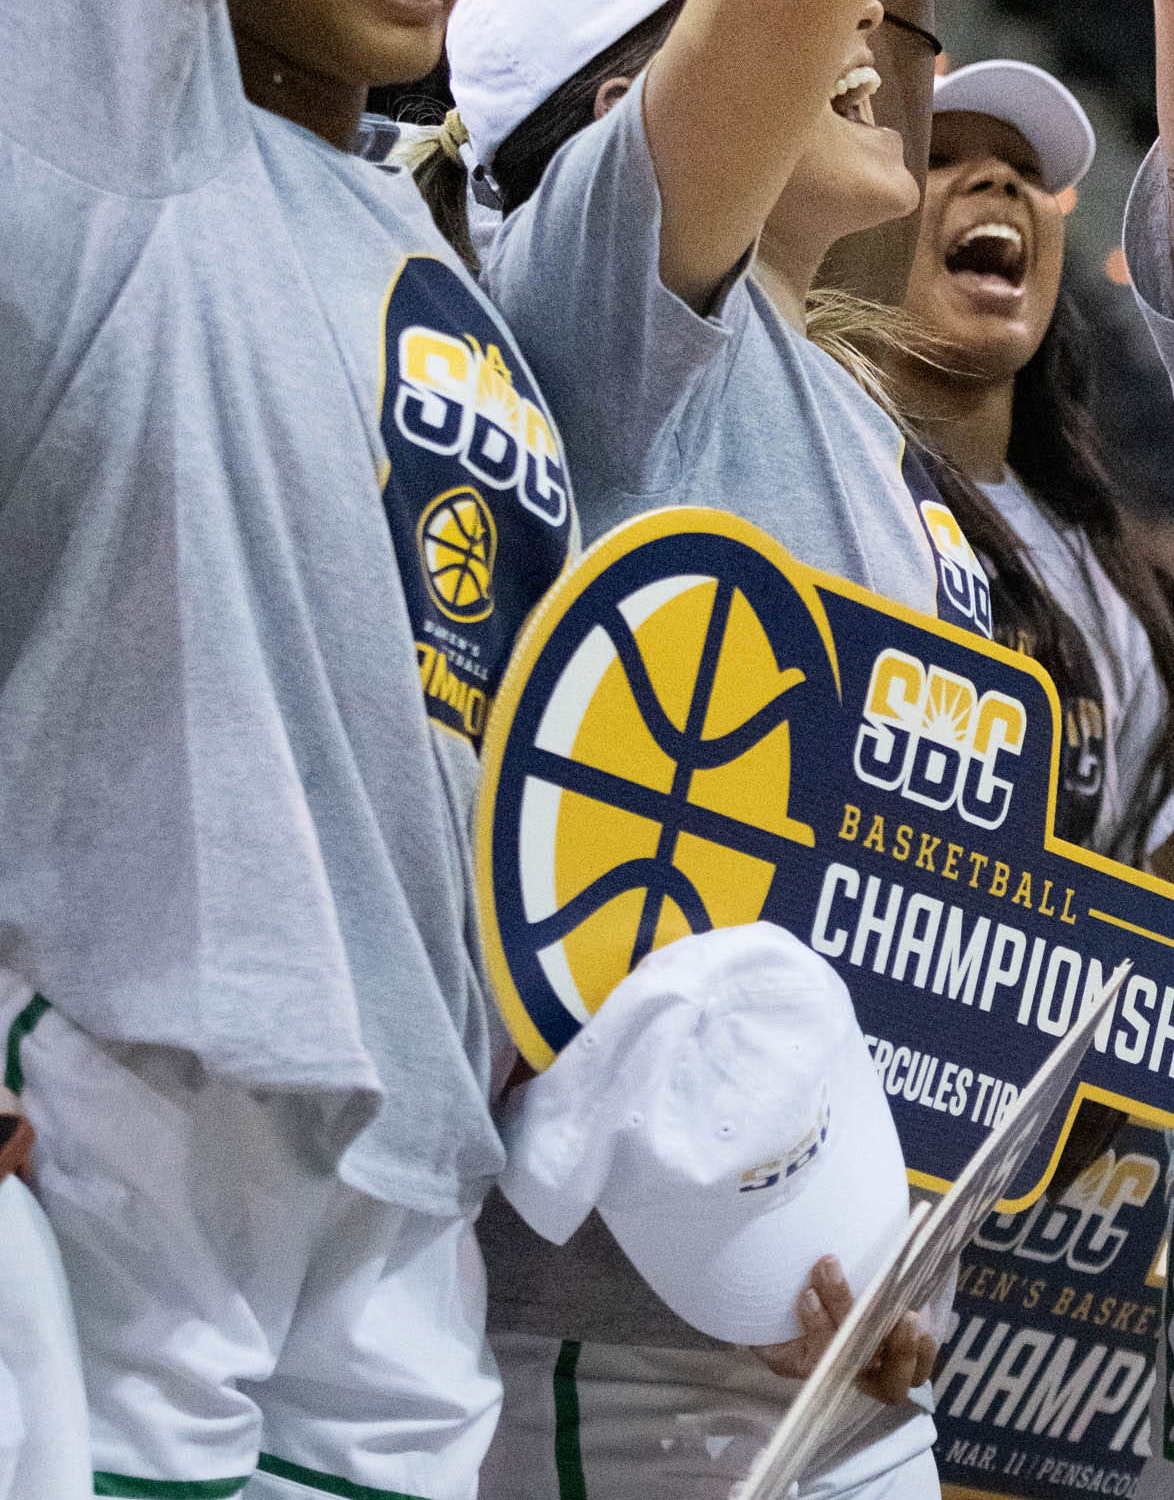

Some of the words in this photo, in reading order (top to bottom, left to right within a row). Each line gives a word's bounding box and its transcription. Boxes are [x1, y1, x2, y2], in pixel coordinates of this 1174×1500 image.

[394, 325, 567, 527] SBC
[854, 647, 1027, 831] SBC
[838, 803, 1077, 925] BASKETBALL
[932, 1312, 1157, 1458] HAMPI
[1036, 1457, 1139, 1499] PENSACO
